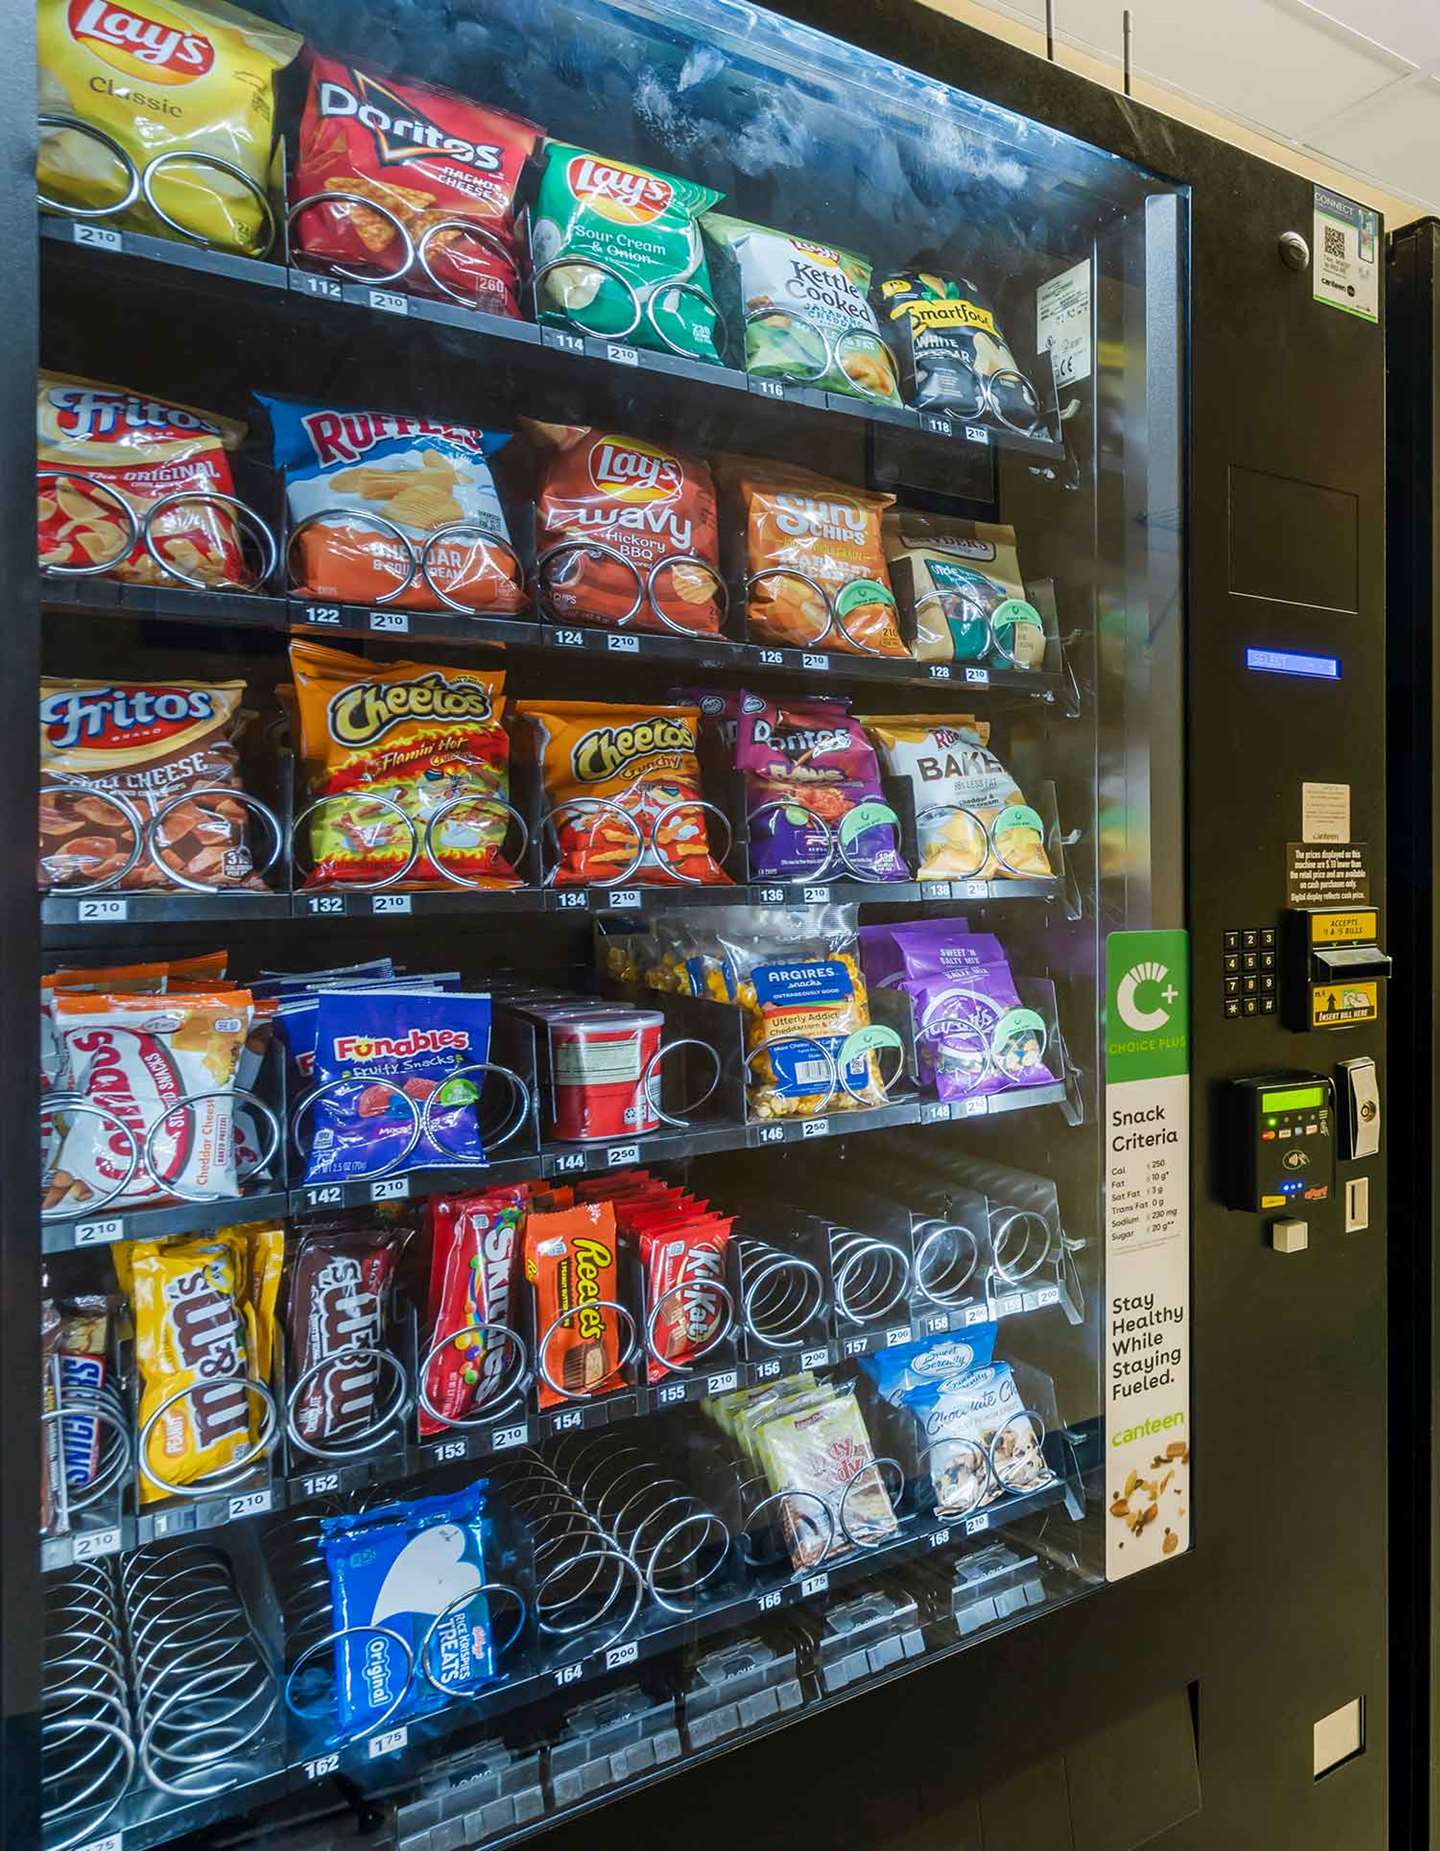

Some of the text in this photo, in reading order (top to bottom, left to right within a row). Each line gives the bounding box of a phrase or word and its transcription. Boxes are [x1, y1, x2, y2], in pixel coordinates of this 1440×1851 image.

[75, 0, 209, 66] Lay's
[89, 76, 184, 118] Classic
[318, 82, 503, 171] Doritos
[439, 174, 493, 199] CHEESE
[574, 158, 669, 207] Lay's
[1314, 191, 1354, 217] CONNECT
[79, 228, 116, 244] 210
[574, 224, 667, 256] Sour Cream
[591, 241, 652, 264] & Onion
[479, 276, 506, 292] 260
[790, 259, 861, 300] Kettle
[1321, 276, 1347, 293] canteen
[308, 278, 403, 308] 112 210
[785, 278, 872, 324] Cooked
[557, 334, 635, 360] 114 210
[914, 335, 959, 349] WHITE
[760, 381, 784, 396] 116
[48, 387, 222, 438] Fritos
[929, 420, 986, 439] 118 210
[122, 460, 221, 482] ORIGINAL
[596, 445, 678, 488] Lay's
[775, 491, 867, 536] Sun
[577, 507, 692, 550] wavy
[809, 522, 867, 546] CHIPS
[608, 530, 666, 554] Hickory
[619, 545, 654, 561] BBQ
[306, 607, 404, 629] 122 210
[555, 630, 635, 649] 124 210
[759, 650, 825, 667] 126 210
[929, 666, 985, 680] 128 210
[40, 686, 215, 748] Fritos
[330, 673, 493, 745] Cheetos
[110, 727, 162, 742] BRAND
[753, 719, 851, 751] Doritos
[381, 736, 470, 771] Flamin' Hot
[574, 717, 695, 783] Cheetos
[123, 751, 210, 789] CHEESE
[620, 754, 682, 780] Crunchy
[916, 751, 1003, 782] BAKE
[1294, 860, 1316, 869] machine
[1316, 861, 1325, 869] are
[1350, 859, 1362, 868] than
[1295, 849, 1305, 859] The
[1305, 850, 1321, 862] prices
[1321, 849, 1345, 861] displayed
[1351, 849, 1361, 859] this
[1289, 869, 1366, 881] the retail price and are available
[1307, 880, 1320, 889] cash
[1320, 880, 1345, 890] purchases
[558, 892, 636, 906] 134 210
[760, 889, 825, 902] 136 210
[930, 884, 950, 896] 138
[1306, 892, 1323, 902] display
[1323, 891, 1341, 900] reflects
[1341, 891, 1352, 899] cash
[83, 902, 120, 918] 210
[308, 897, 404, 913] 132 210
[1330, 919, 1359, 927] ACCEPTS
[1344, 927, 1363, 935] BILLS
[939, 948, 966, 957] SWEET
[939, 956, 980, 965] SALTY MIX
[767, 967, 835, 983] ARGIRES
[771, 1014, 806, 1028] Utterly
[1318, 1008, 1369, 1022] INSERT BILL HERE
[333, 1029, 469, 1063] Funables
[1108, 1035, 1187, 1055] CHOICE PLUS
[144, 1051, 174, 1092] SNACKS
[352, 1056, 455, 1077] Fruity Snacks
[1112, 1104, 1166, 1127] Snack
[760, 1122, 826, 1141] 146 250
[1112, 1128, 1179, 1152] Criteria
[196, 1136, 214, 1186] Cheddar
[556, 1148, 636, 1170] 144 250
[1111, 1159, 1166, 1176] Cal 250
[306, 1181, 404, 1205] 142 210
[1111, 1180, 1125, 1189] Fat
[1111, 1190, 1141, 1202] Sat Fat
[1111, 1201, 1149, 1215] Trans Fat
[1111, 1208, 1178, 1228] Sodium 230 mg
[79, 1223, 116, 1241] 210
[1111, 1230, 1135, 1241] Sugar
[572, 1238, 613, 1340] Reese's
[1040, 1290, 1058, 1303] 200
[1112, 1292, 1155, 1315] Stay
[927, 1316, 948, 1331] 158
[1112, 1305, 1185, 1336] Healthy
[846, 1330, 909, 1354] 157 200
[1111, 1331, 1164, 1357] While
[756, 1351, 826, 1378] 156 200
[1112, 1348, 1182, 1379] Staying
[659, 1376, 733, 1404] 155 210
[1112, 1368, 1175, 1400] Fueled.
[552, 1413, 582, 1430] 154
[1111, 1410, 1186, 1447] canteen
[434, 1428, 522, 1461] 153 210
[303, 1475, 339, 1494] 152
[232, 1495, 264, 1514] 210
[929, 1517, 985, 1547] 168 210
[78, 1534, 113, 1555] 210
[758, 1577, 826, 1611] 166 175
[436, 1619, 459, 1684] TREATS
[455, 1612, 471, 1680] RICE KRISPIES
[363, 1637, 392, 1706] Original
[554, 1647, 636, 1685] 164 200
[304, 1731, 402, 1780] 162 175
